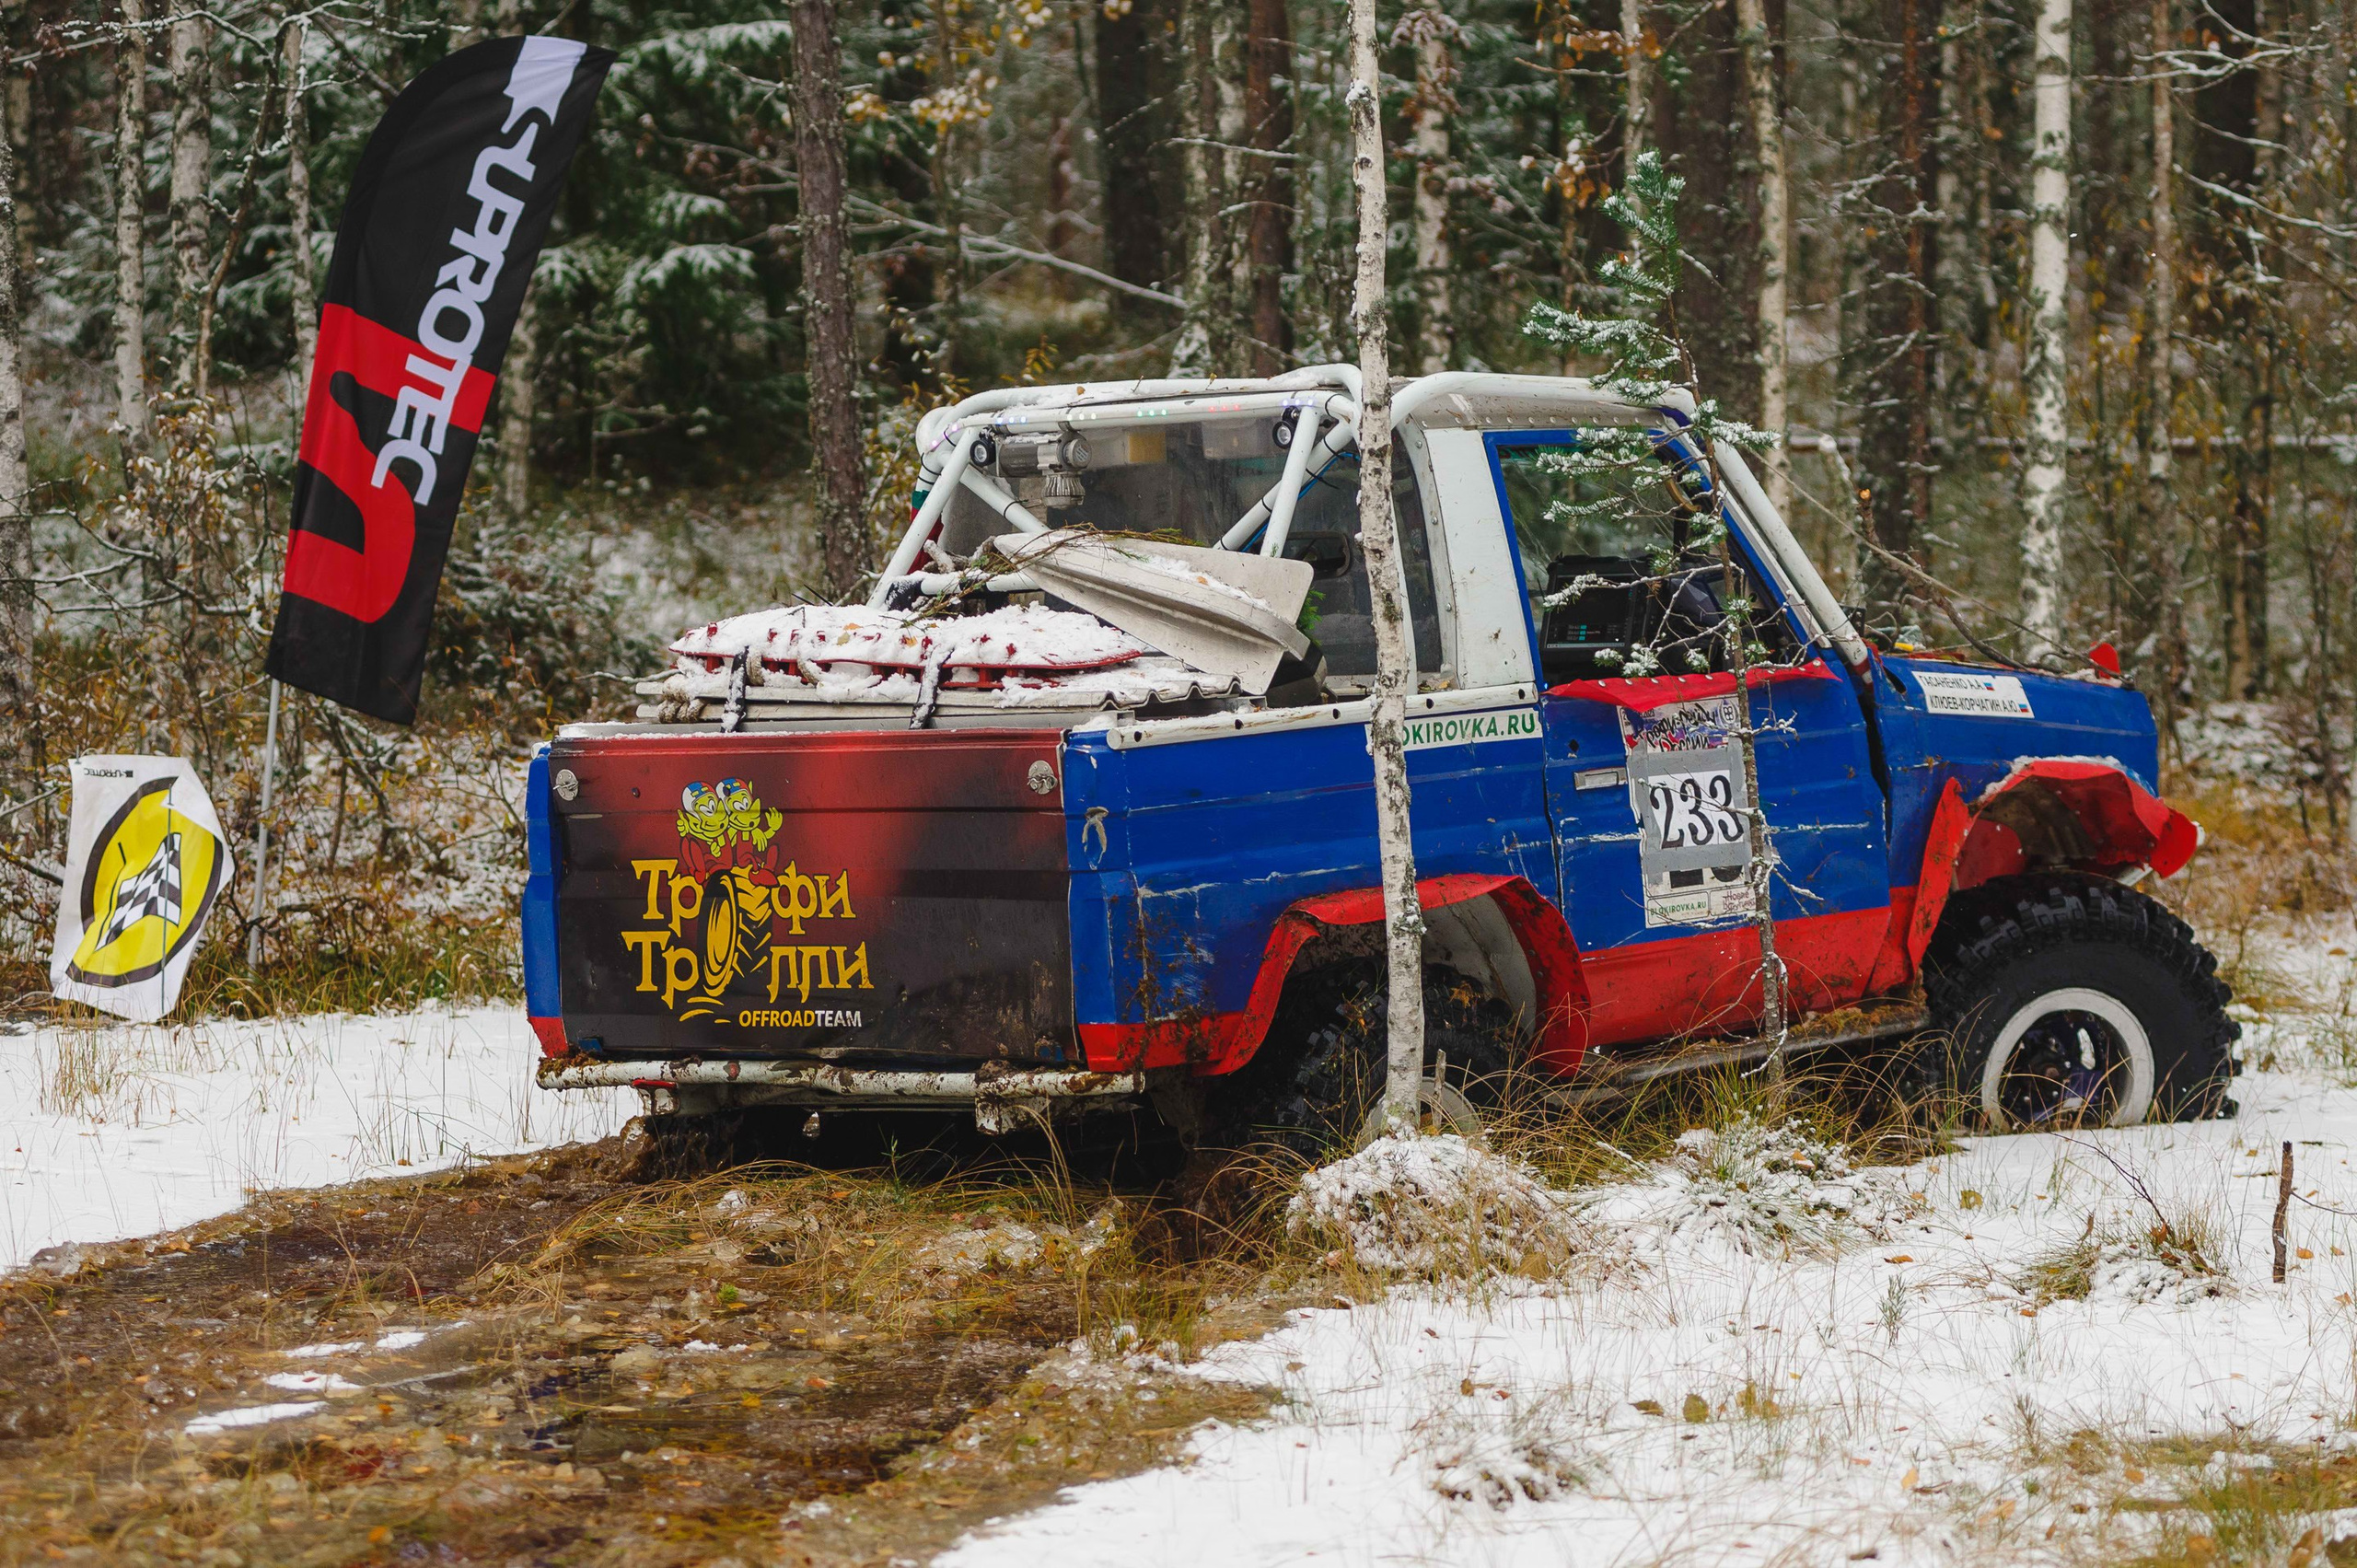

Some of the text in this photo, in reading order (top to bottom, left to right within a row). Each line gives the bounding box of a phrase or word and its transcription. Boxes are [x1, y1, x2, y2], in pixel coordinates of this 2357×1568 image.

[1402, 713, 1536, 747] OKIROVKA.RU
[1649, 774, 1745, 849] 233
[738, 1009, 863, 1028] OFFROADTEAM
